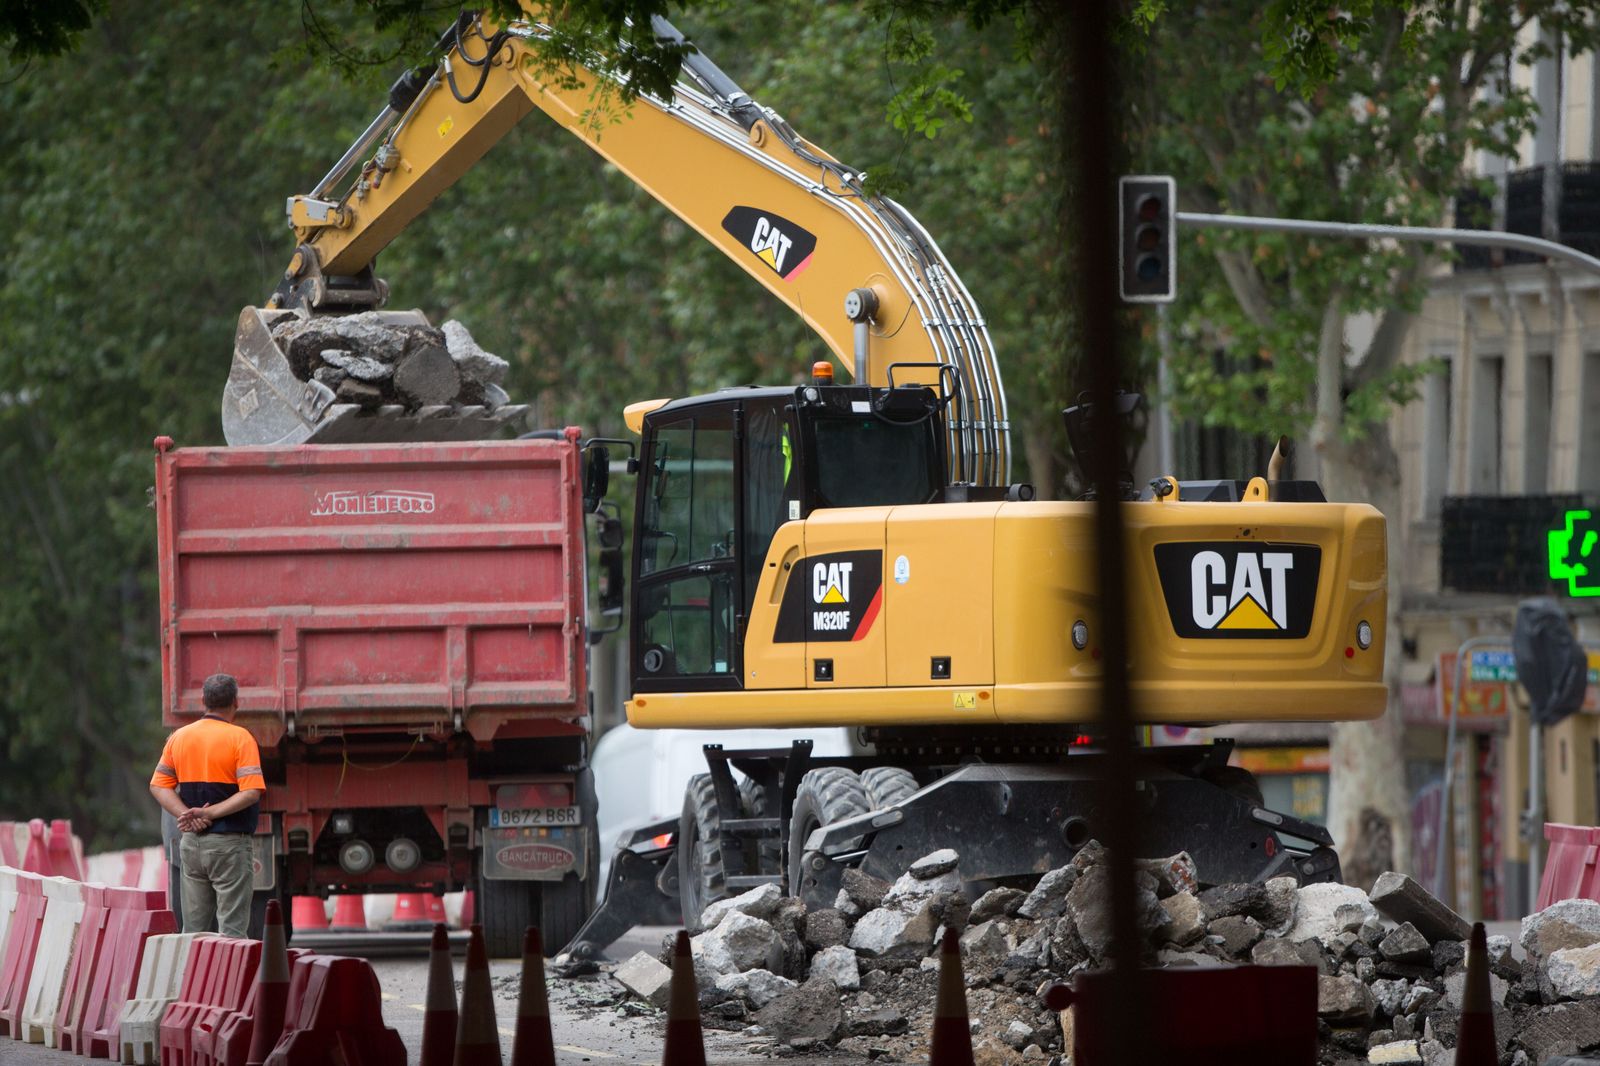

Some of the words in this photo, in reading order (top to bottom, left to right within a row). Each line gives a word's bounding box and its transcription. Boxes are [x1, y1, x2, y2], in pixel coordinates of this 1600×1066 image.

[751, 216, 793, 273] CAT
[813, 562, 853, 604] CAT
[1191, 550, 1293, 630] CAT
[813, 610, 850, 631] M320F
[501, 808, 541, 825] 0672
[546, 807, 576, 823] BSR
